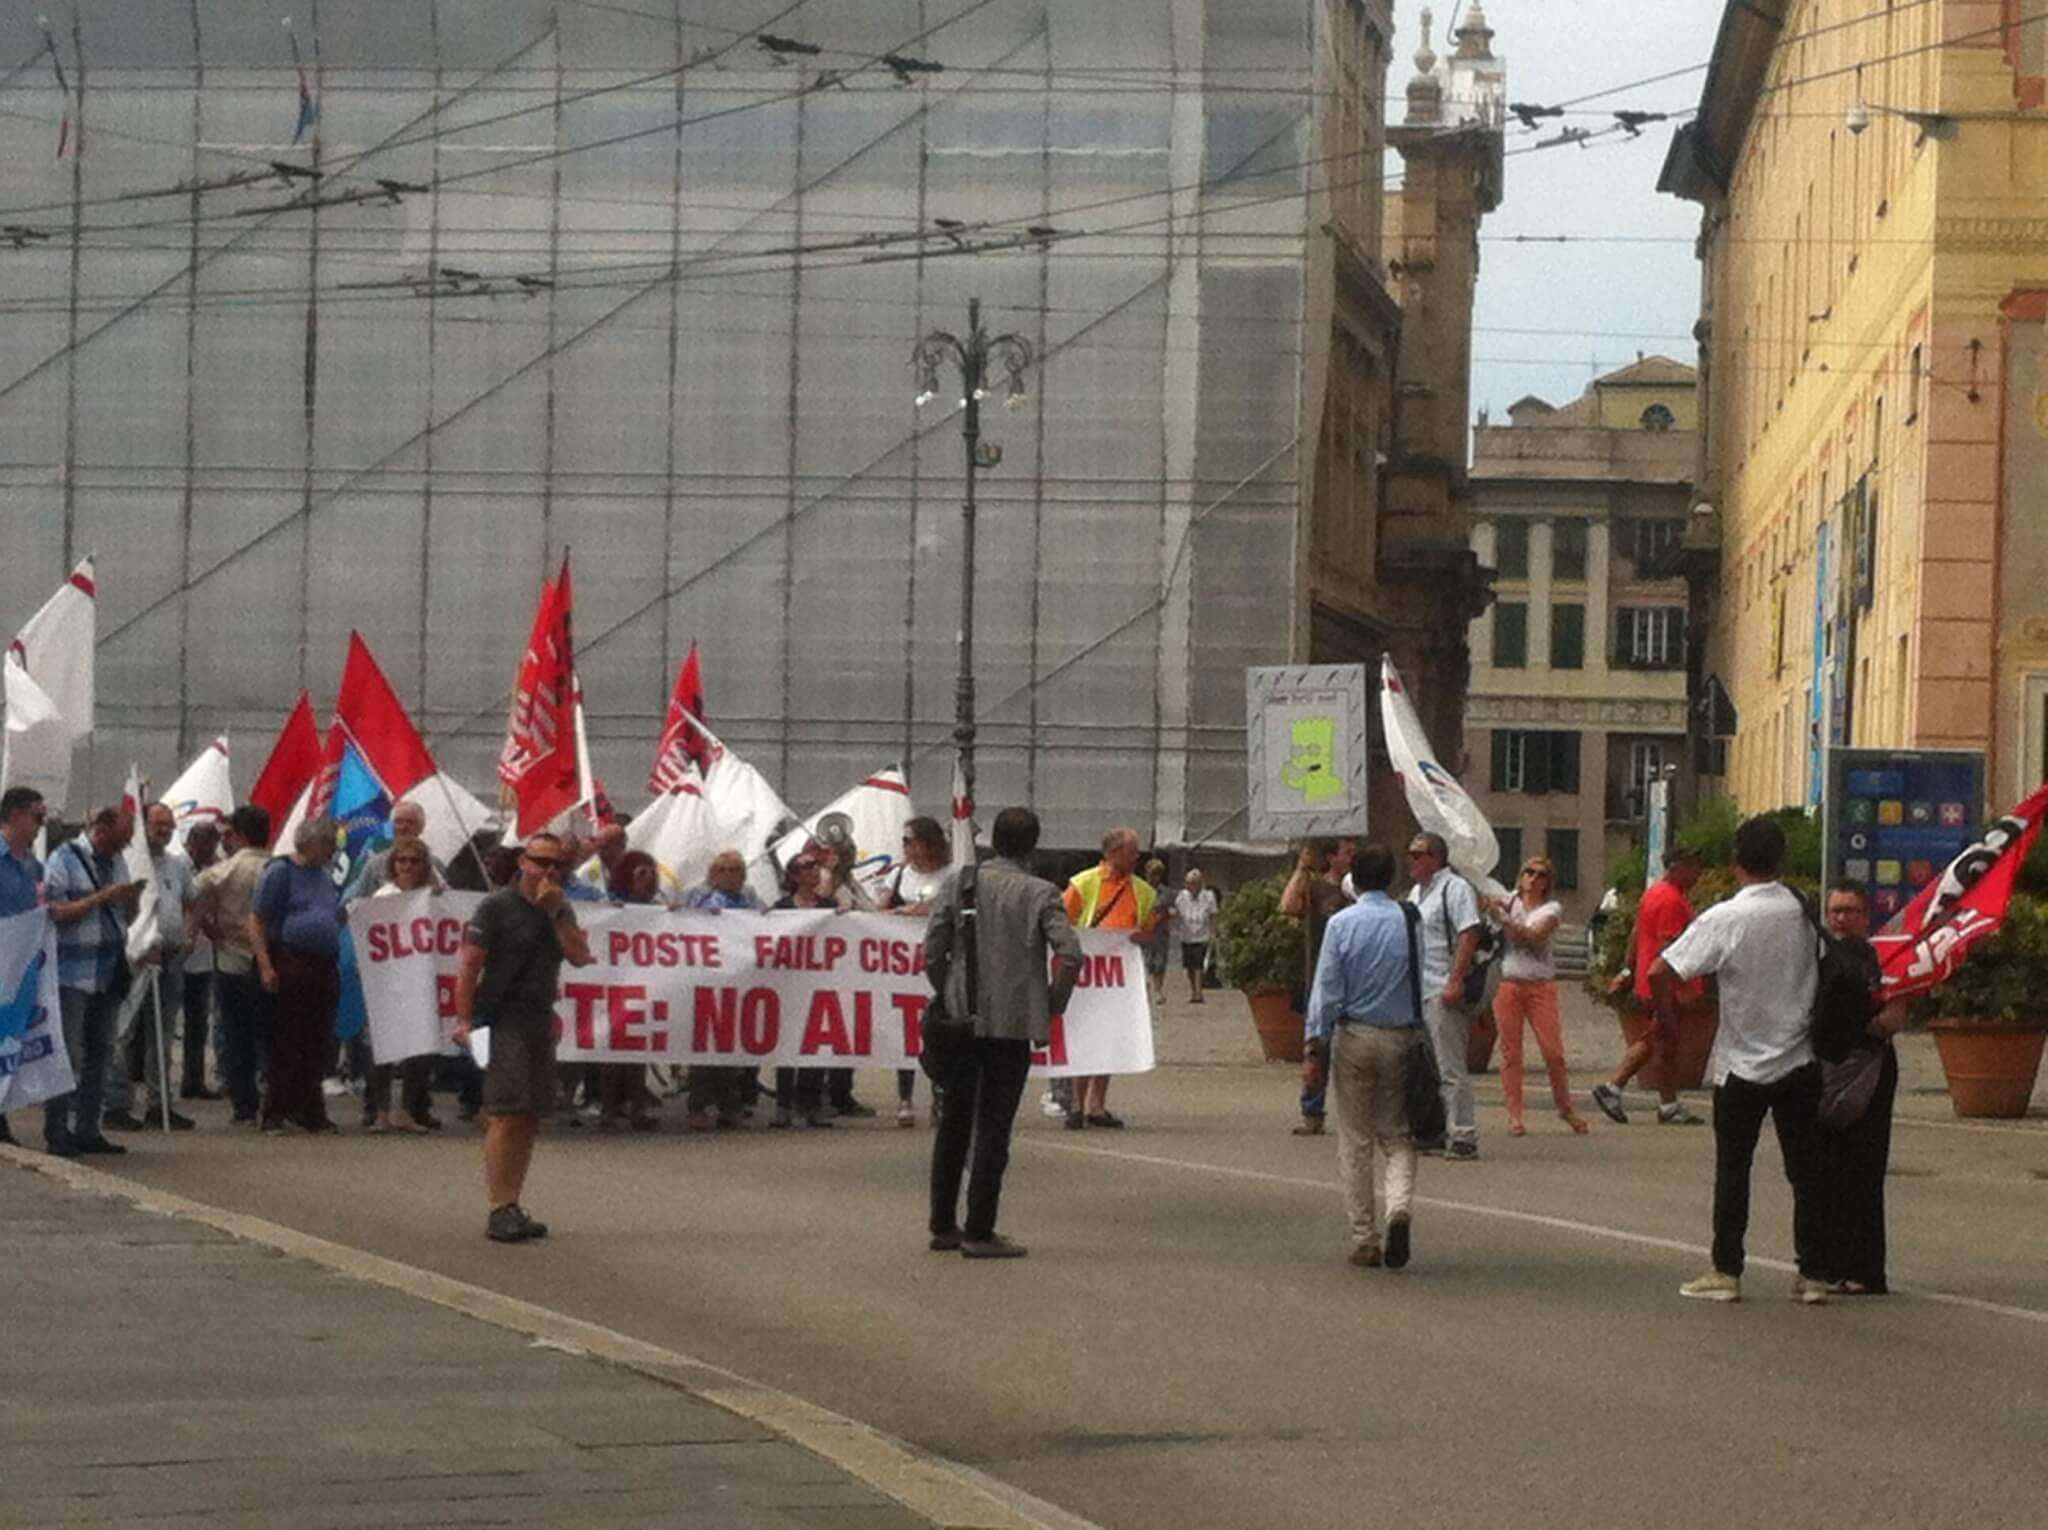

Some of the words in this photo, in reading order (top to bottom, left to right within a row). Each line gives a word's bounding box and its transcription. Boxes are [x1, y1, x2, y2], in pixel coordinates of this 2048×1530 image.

[608, 930, 722, 968] POSTE
[755, 934, 847, 971] FAILP
[692, 985, 780, 1057] NO
[799, 990, 873, 1057] AI
